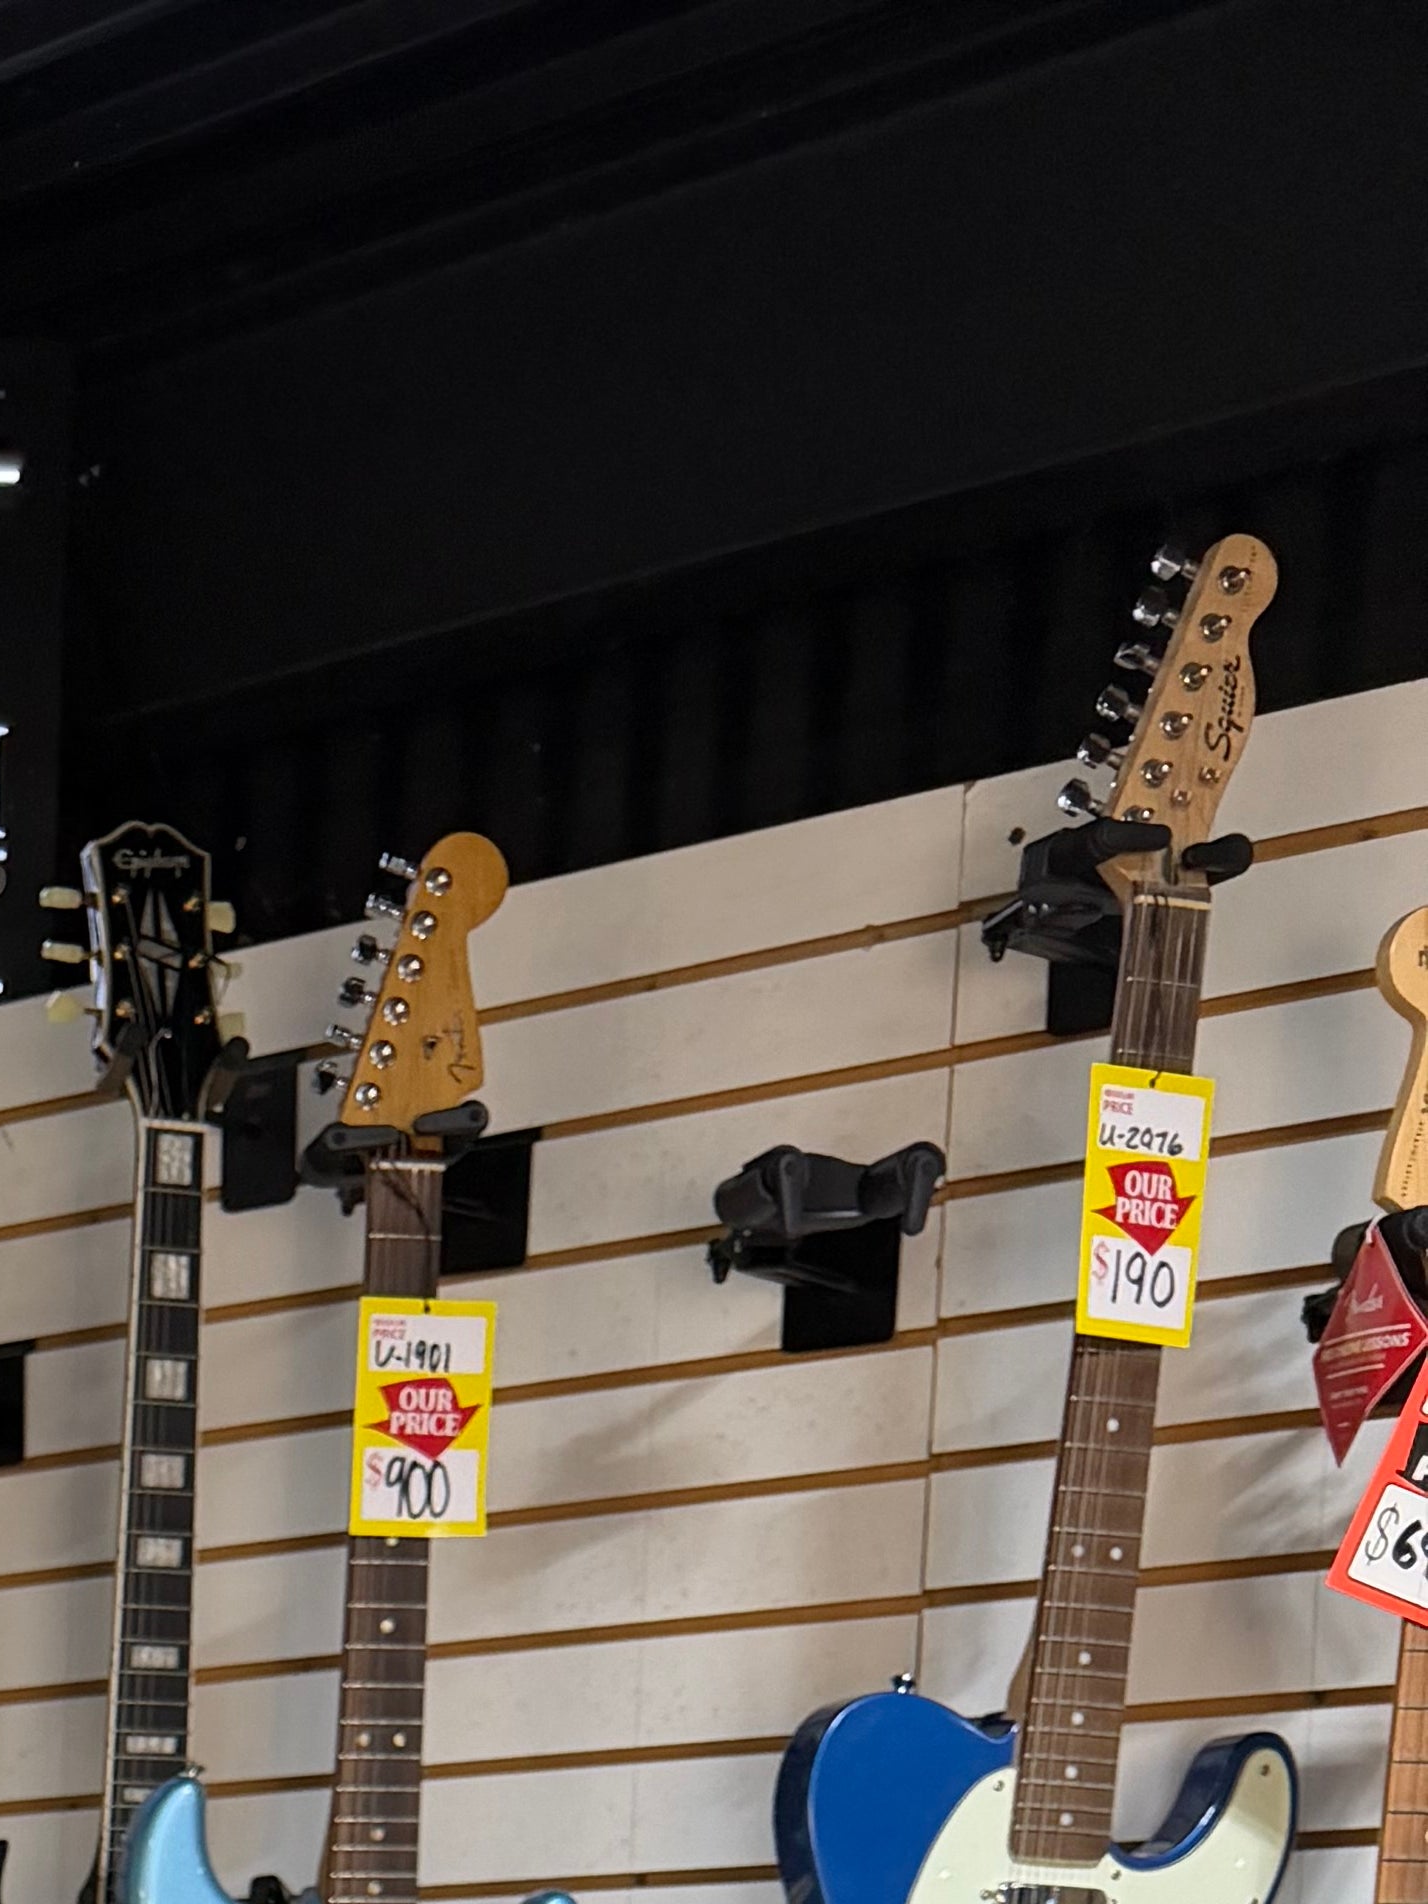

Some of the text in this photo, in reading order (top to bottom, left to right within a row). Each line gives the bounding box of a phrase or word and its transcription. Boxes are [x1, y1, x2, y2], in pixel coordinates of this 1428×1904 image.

[1204, 655, 1245, 761] Squier
[1124, 1169, 1173, 1201] OUR
[1114, 1195, 1179, 1230] PRICE
[1092, 1240, 1175, 1309] $190
[398, 1386, 453, 1412] OUR
[389, 1412, 462, 1437] PRICE
[365, 1452, 451, 1520] $900
